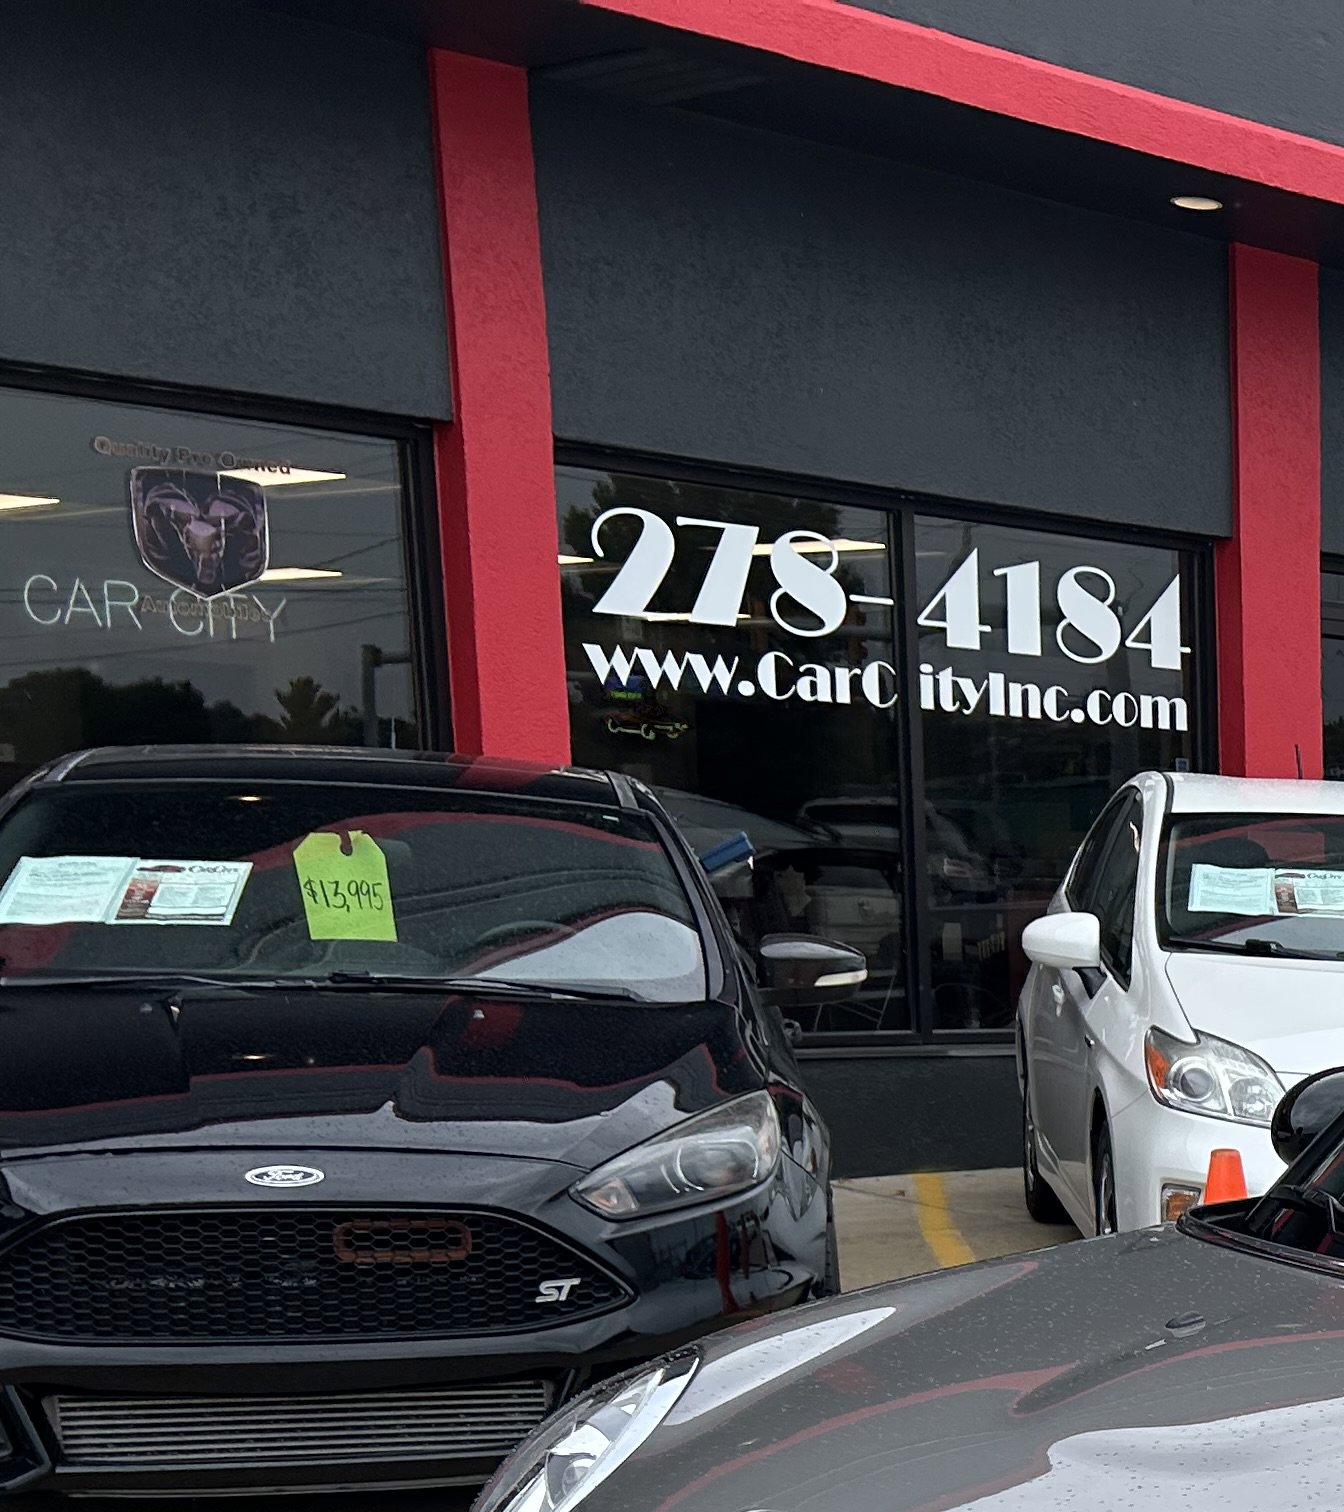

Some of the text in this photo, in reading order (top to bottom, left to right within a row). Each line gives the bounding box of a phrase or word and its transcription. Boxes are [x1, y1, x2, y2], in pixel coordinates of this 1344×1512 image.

[24, 574, 287, 643] CAR CITY
[582, 642, 1189, 732] www.CarCityInc.com
[303, 875, 384, 913] $13,995
[535, 1277, 581, 1303] ST
